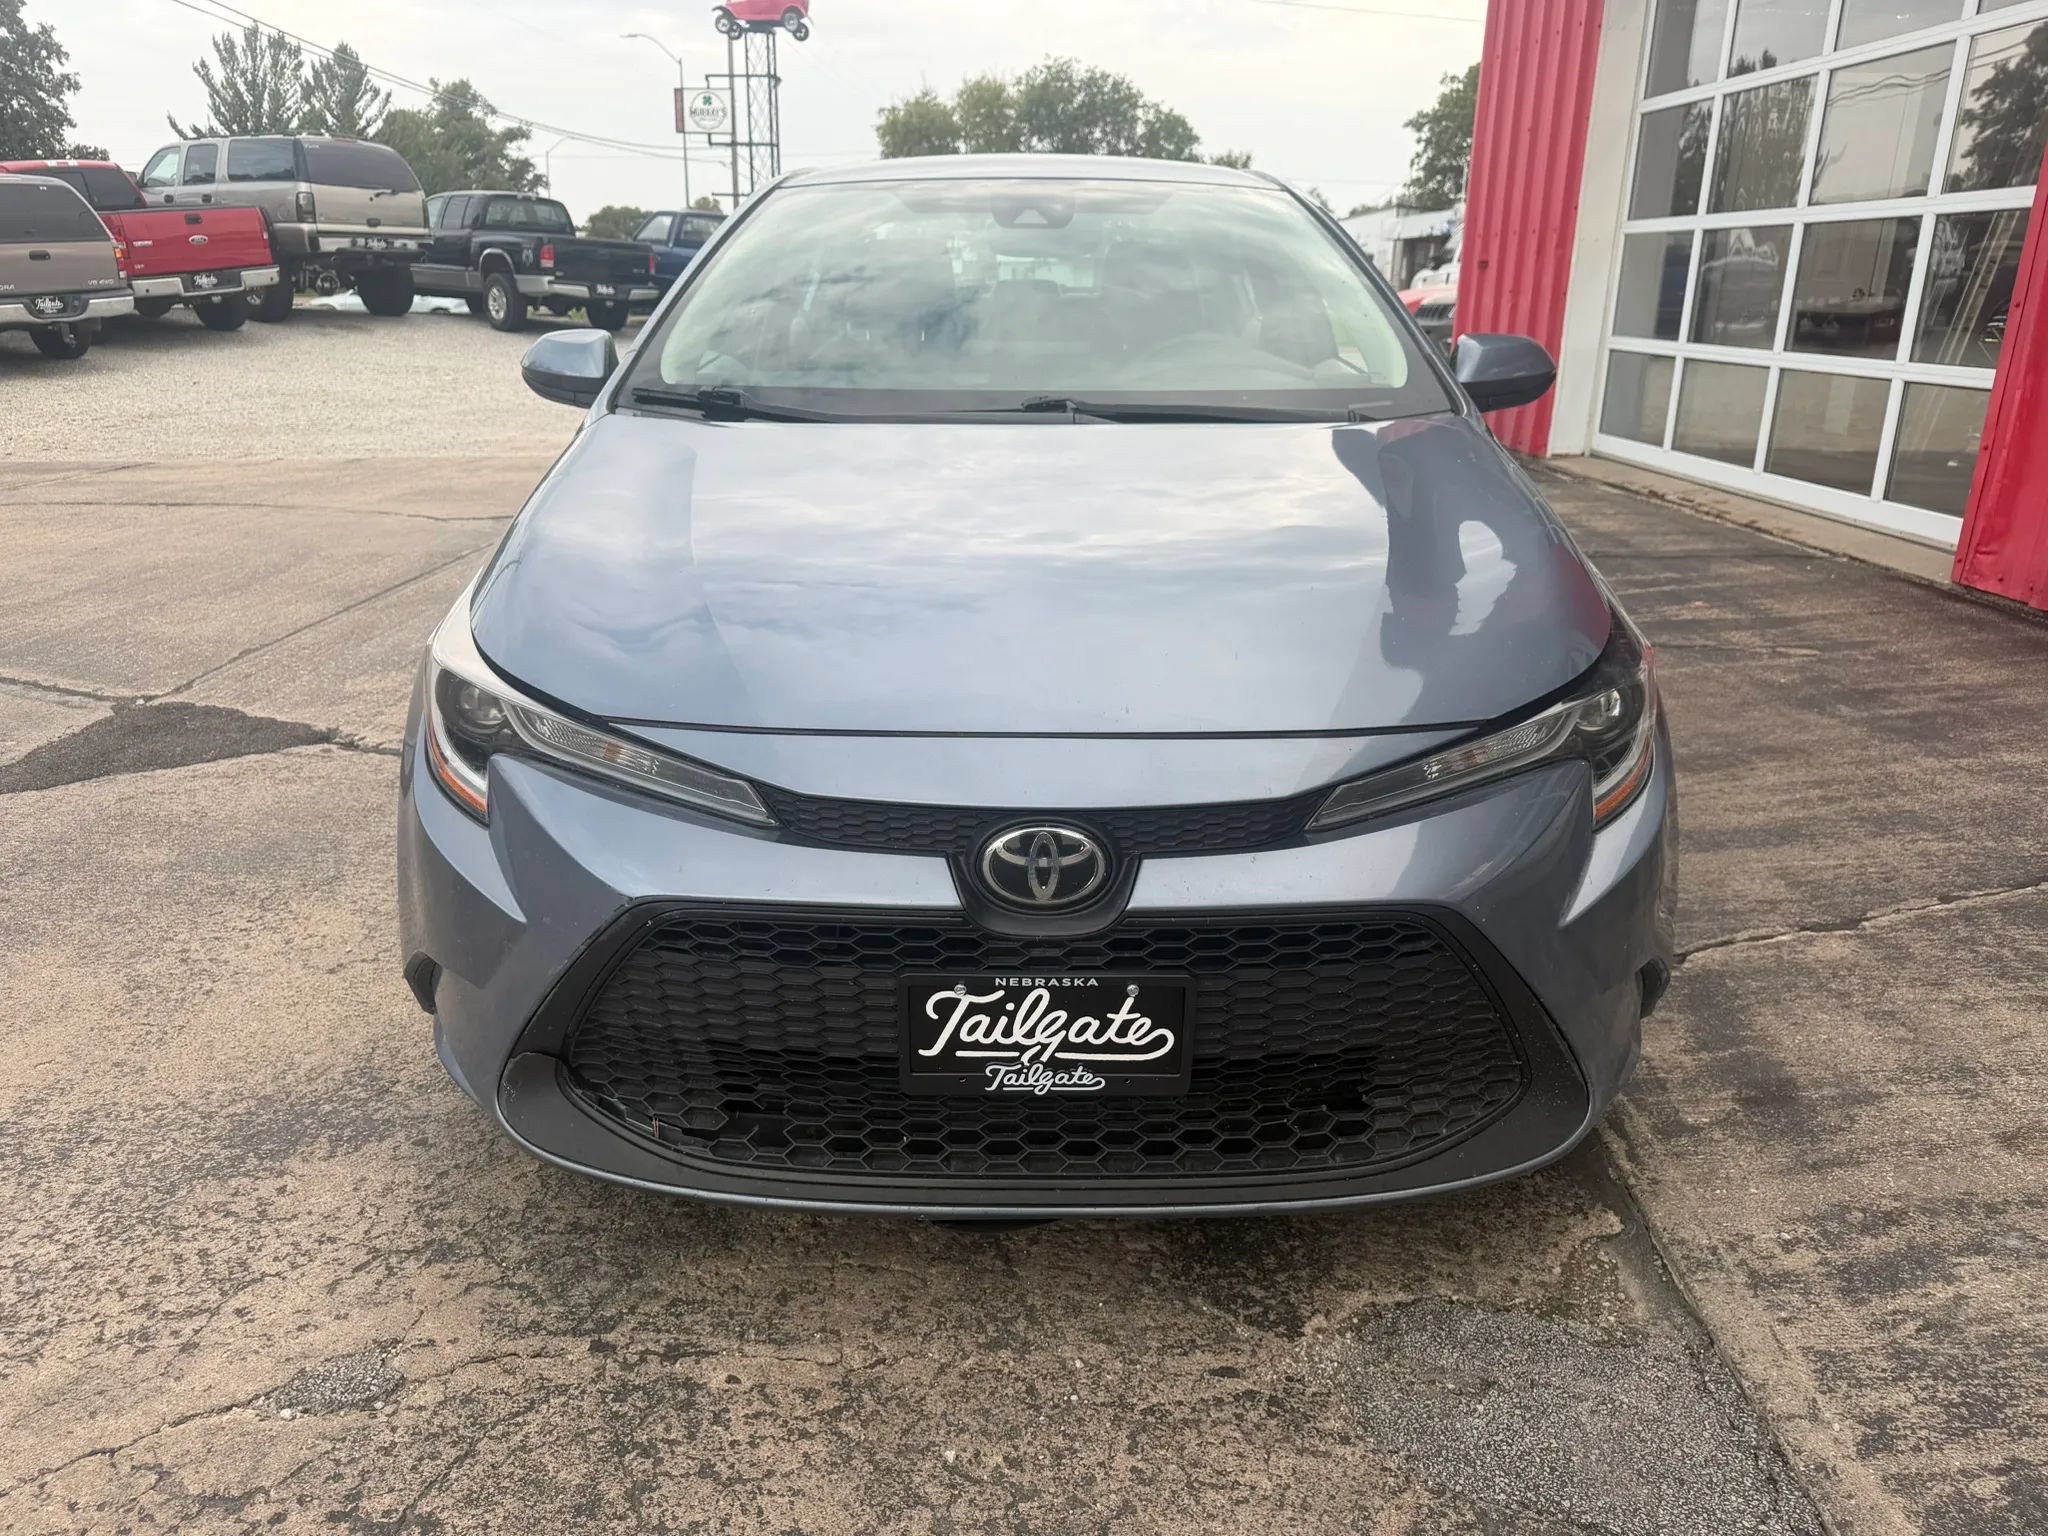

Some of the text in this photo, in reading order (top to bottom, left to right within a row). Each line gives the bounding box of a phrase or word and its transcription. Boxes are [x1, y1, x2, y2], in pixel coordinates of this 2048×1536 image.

[994, 977, 1099, 987] NEBRASKA
[918, 987, 1175, 1066] Tailgate
[984, 1062, 1106, 1095] Tailgate
